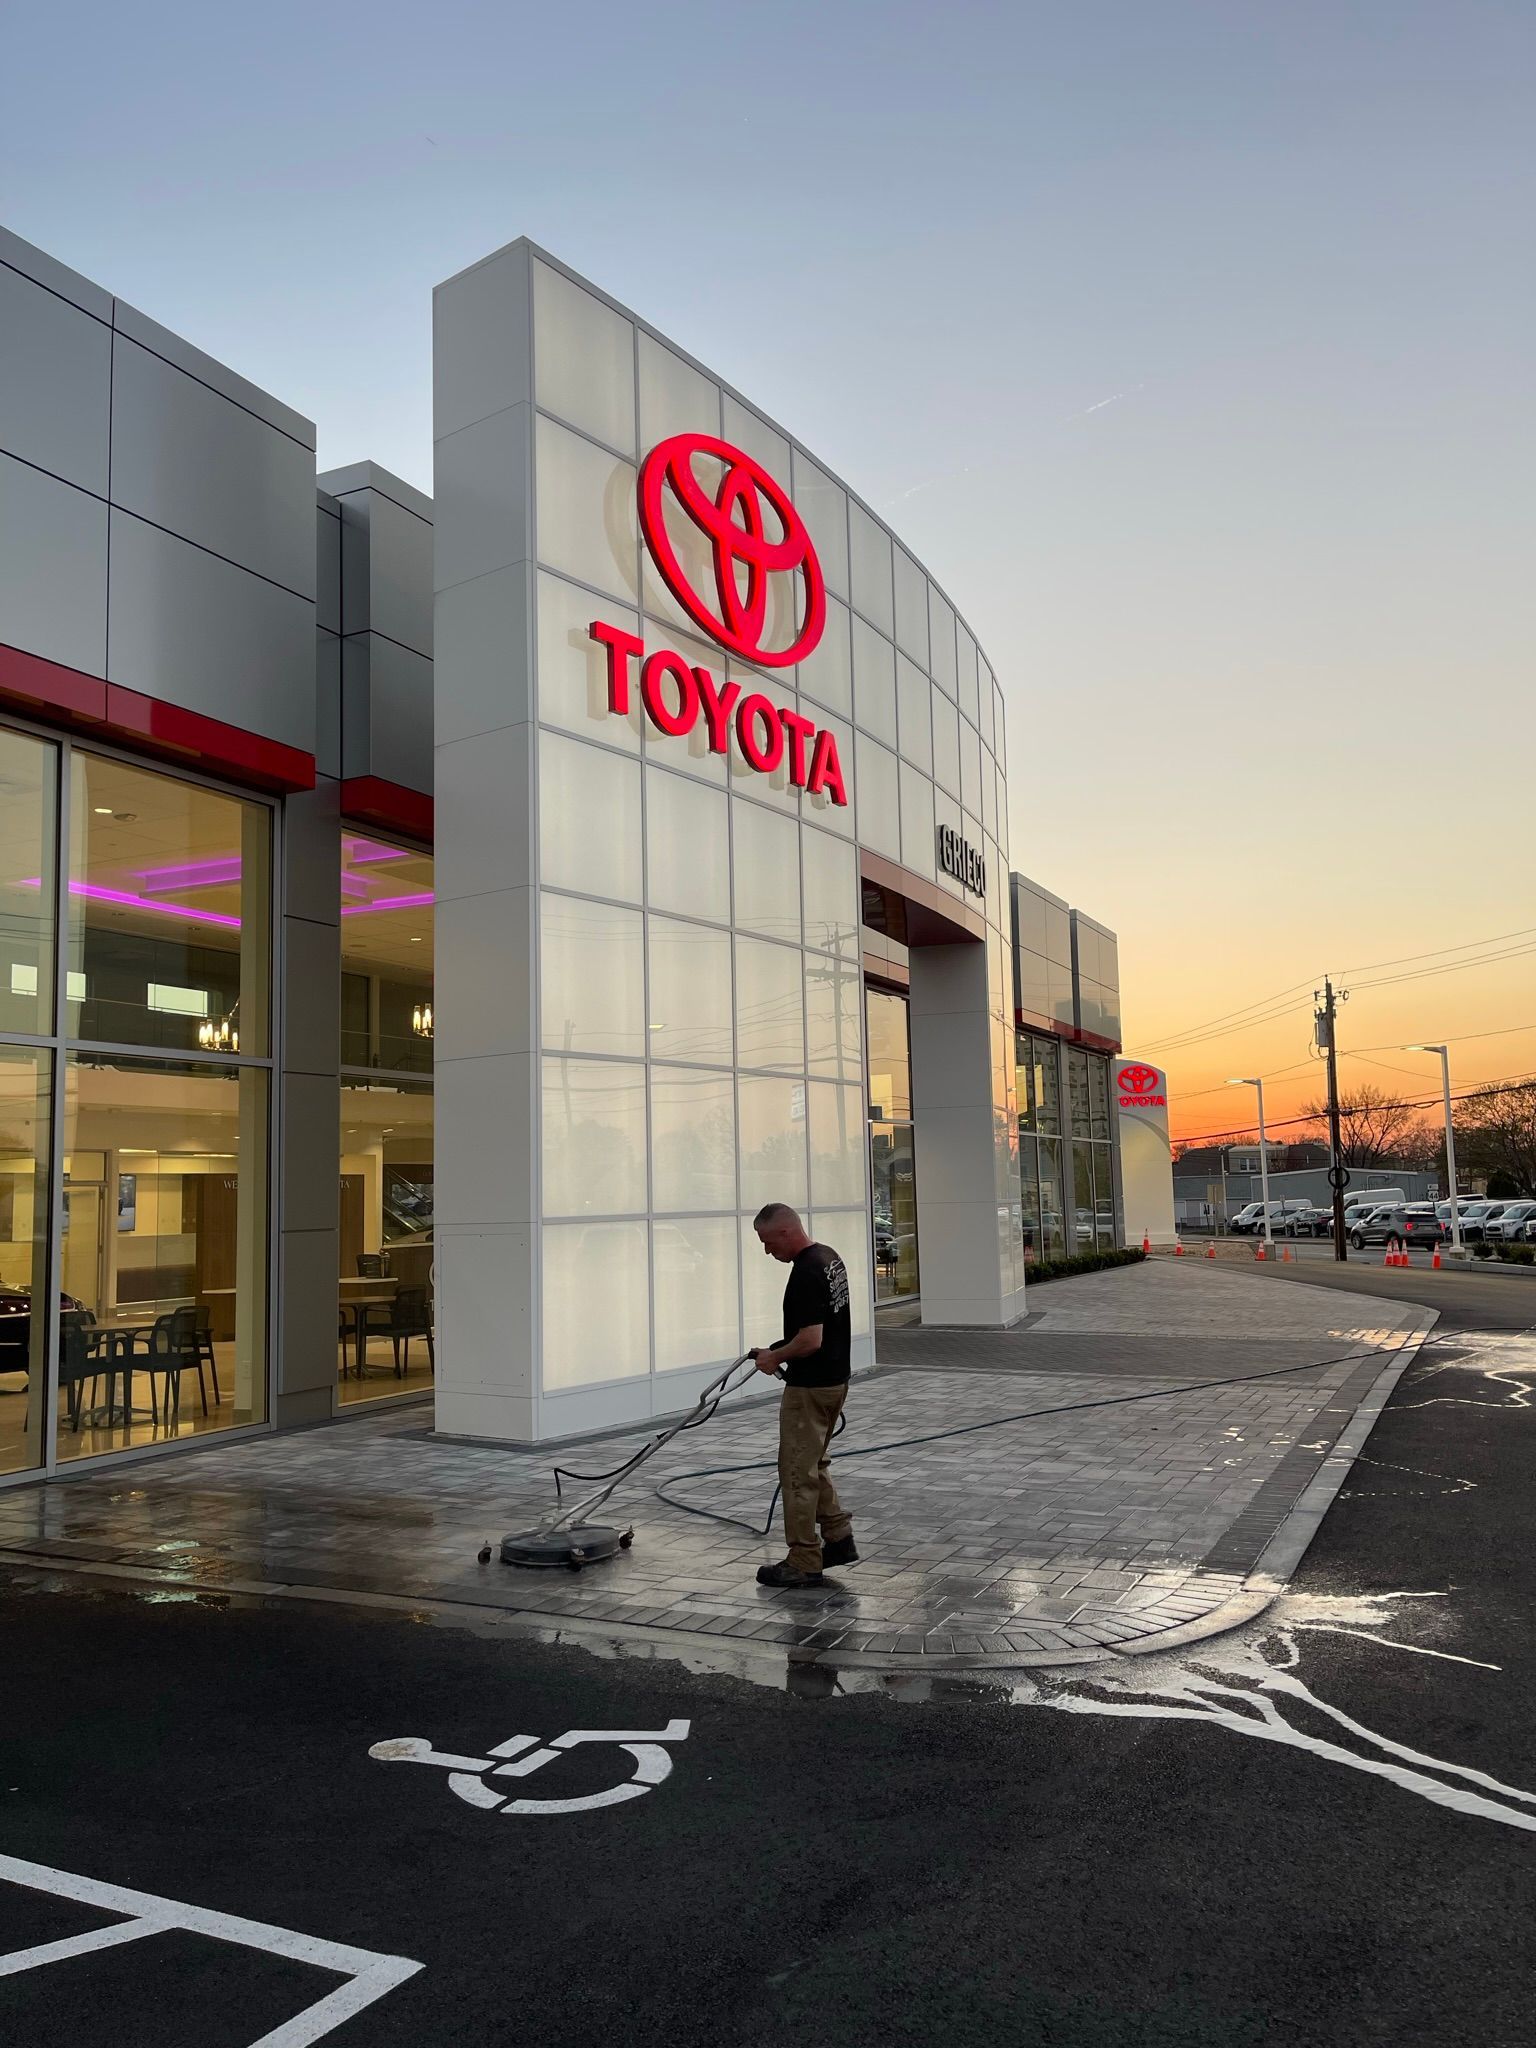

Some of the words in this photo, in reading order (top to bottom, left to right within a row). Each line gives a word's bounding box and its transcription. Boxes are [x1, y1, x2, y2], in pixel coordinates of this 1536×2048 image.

[589, 621, 847, 807] TOYOTA
[940, 824, 987, 898] GRIECO
[1119, 1096, 1166, 1107] OYOTA
